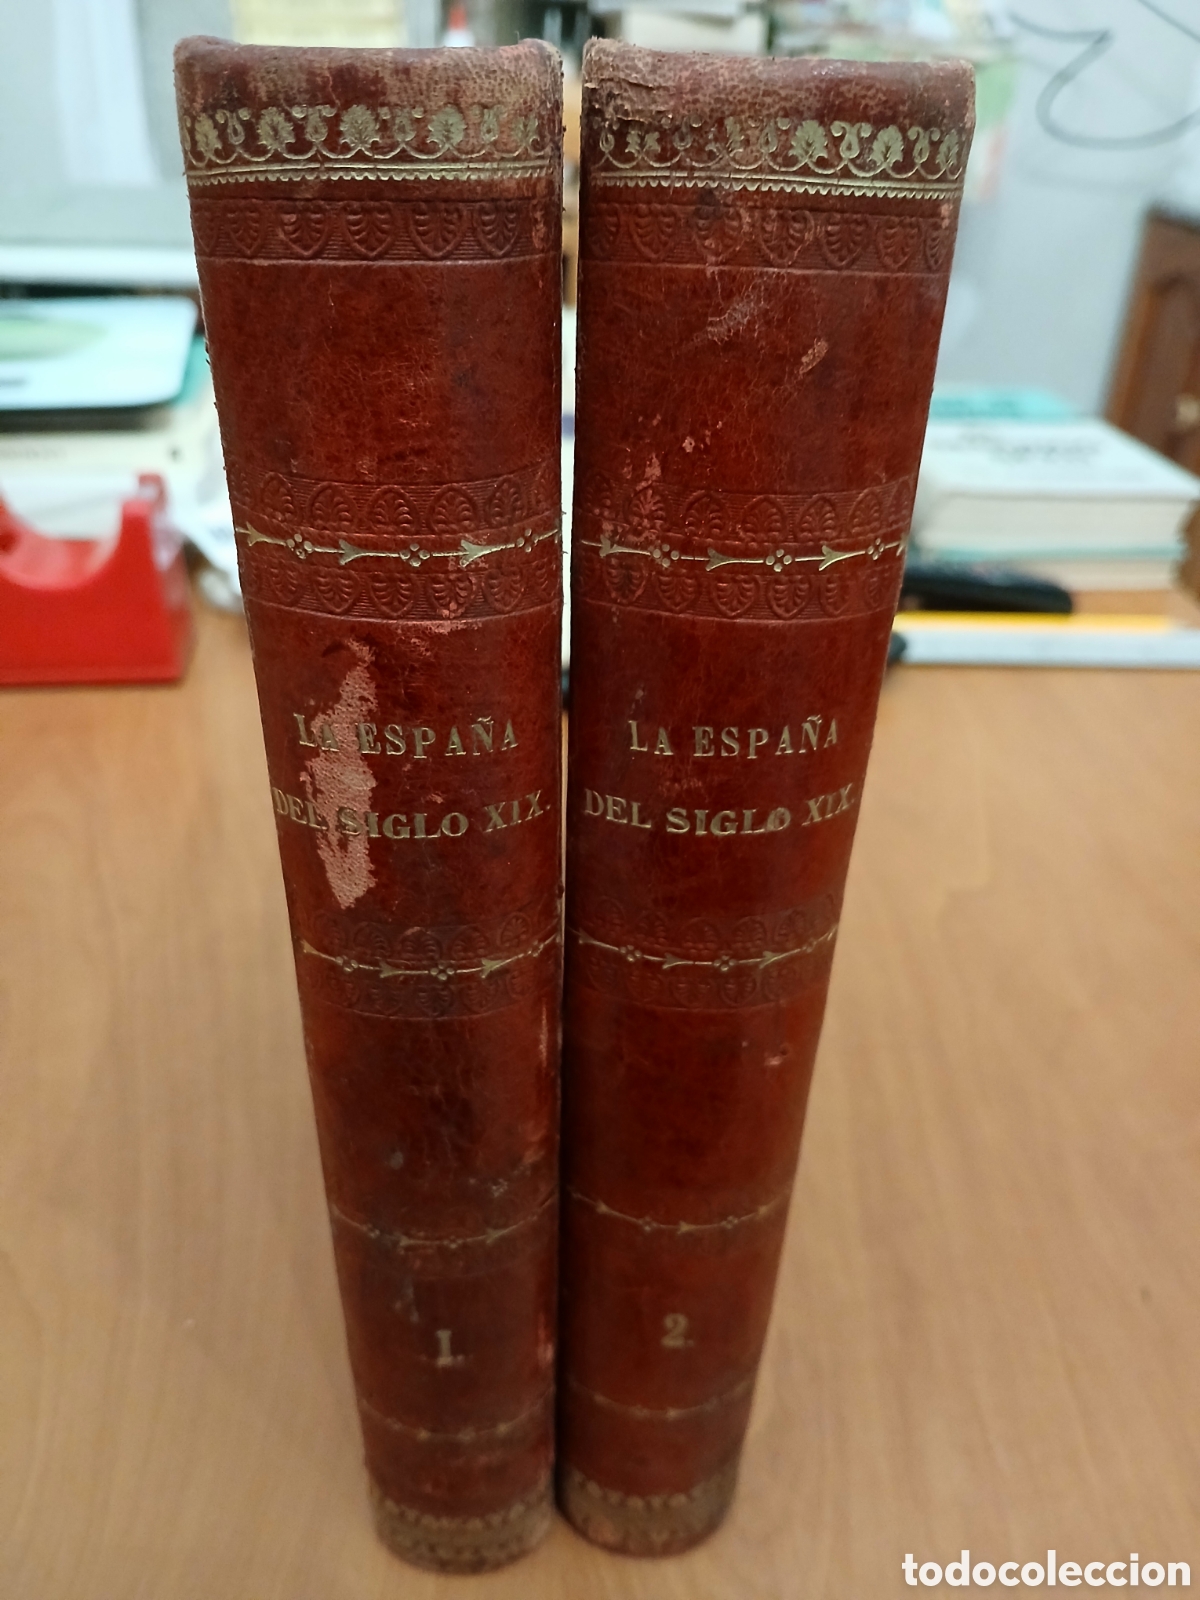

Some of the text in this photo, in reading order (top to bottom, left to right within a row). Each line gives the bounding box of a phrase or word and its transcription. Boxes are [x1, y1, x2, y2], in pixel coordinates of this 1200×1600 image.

[293, 712, 519, 759] LA ESPAÑA
[627, 714, 839, 760] LA ESPAÑA
[271, 786, 551, 839] DEL SIGLO XIX.
[584, 788, 652, 829] DEL
[665, 806, 791, 837] SIGLO
